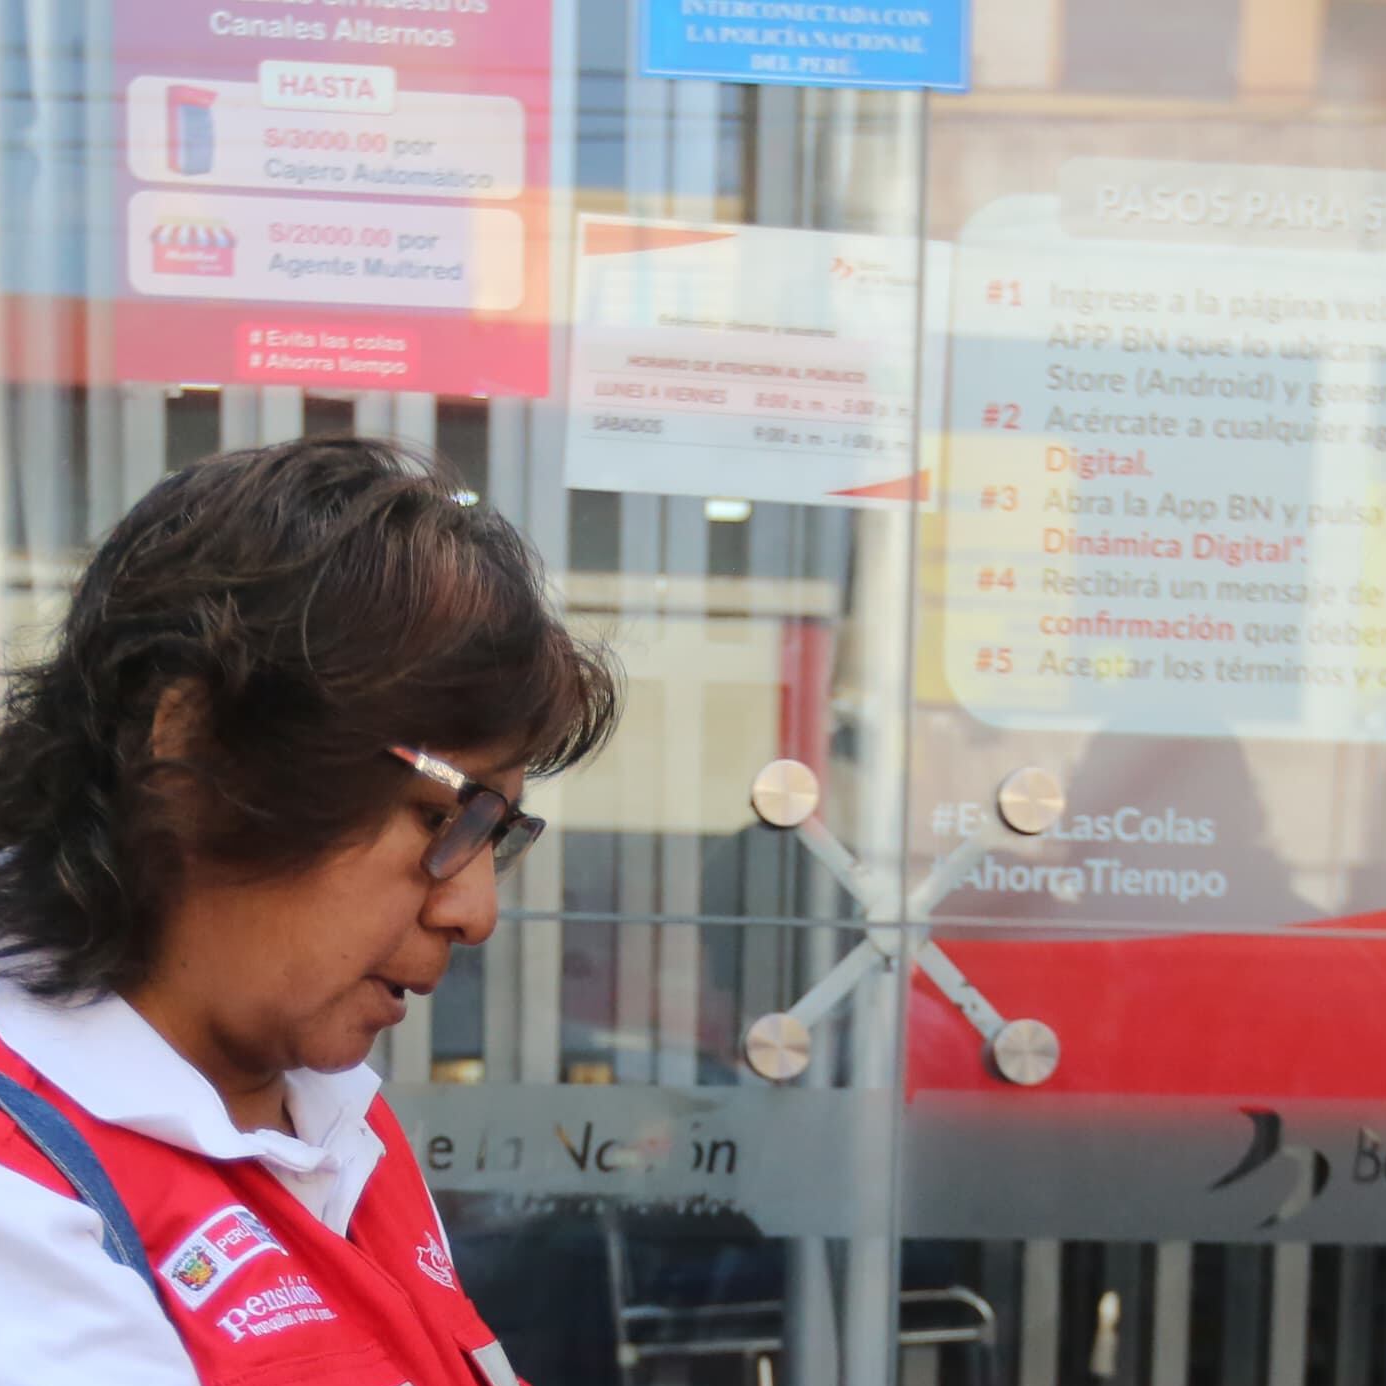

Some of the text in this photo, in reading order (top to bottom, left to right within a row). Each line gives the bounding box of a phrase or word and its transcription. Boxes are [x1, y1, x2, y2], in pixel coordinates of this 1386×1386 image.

[209, 11, 455, 48] Canales Alternos
[883, 9, 931, 27] CON
[686, 24, 718, 43] LA
[812, 31, 926, 54] NACIONAL
[750, 54, 795, 71] DEL
[278, 74, 377, 101] HASTA
[263, 127, 436, 157] S/3000.00 por
[265, 158, 493, 190] Cajero Automático
[1097, 185, 1229, 230] PASOS
[1244, 191, 1349, 234] PARA
[268, 222, 439, 252] S/2000.00 por
[269, 254, 464, 281] Agente Multired
[986, 279, 1022, 307] #1
[1049, 281, 1159, 316] Ingrese
[1172, 297, 1186, 314] a
[1196, 289, 1221, 315] la
[1230, 293, 1328, 326] página
[267, 330, 316, 348] Evita
[321, 331, 348, 350] las
[354, 334, 407, 352] colas
[1047, 323, 1110, 351] APP
[1121, 326, 1168, 353] BN
[1177, 334, 1230, 360] que
[1242, 330, 1270, 359] lo
[267, 354, 333, 372] Ahorra
[339, 356, 407, 376] tiempo
[595, 382, 643, 399] LUNES
[665, 387, 727, 404] VIERNES
[1045, 364, 1126, 395] Store
[1136, 366, 1275, 402] (Android)
[1284, 382, 1301, 404] y
[982, 403, 1021, 430] #2
[1044, 405, 1181, 437] Acércate
[1192, 417, 1205, 437] a
[1213, 410, 1350, 444] cualquier
[1045, 446, 1154, 481] Digital.
[980, 485, 1018, 512] #3
[1043, 486, 1112, 517] Abra
[1124, 488, 1148, 518] la
[1156, 492, 1216, 525] App
[1227, 494, 1274, 521] BN
[1281, 503, 1299, 528] y
[1309, 498, 1385, 528] pulsa
[1043, 526, 1182, 560] Dinámica
[977, 567, 1016, 593] #4
[1040, 568, 1161, 601] Recibirá
[1170, 579, 1208, 600] un
[1216, 577, 1338, 610] mensaje
[1347, 579, 1383, 607] de
[1039, 610, 1235, 642] confirmación
[1244, 620, 1299, 650] que
[974, 647, 1013, 674] #5
[1037, 648, 1154, 683] Aceptar
[1163, 650, 1204, 681] los
[1214, 651, 1344, 686] términos
[1352, 666, 1370, 688] y
